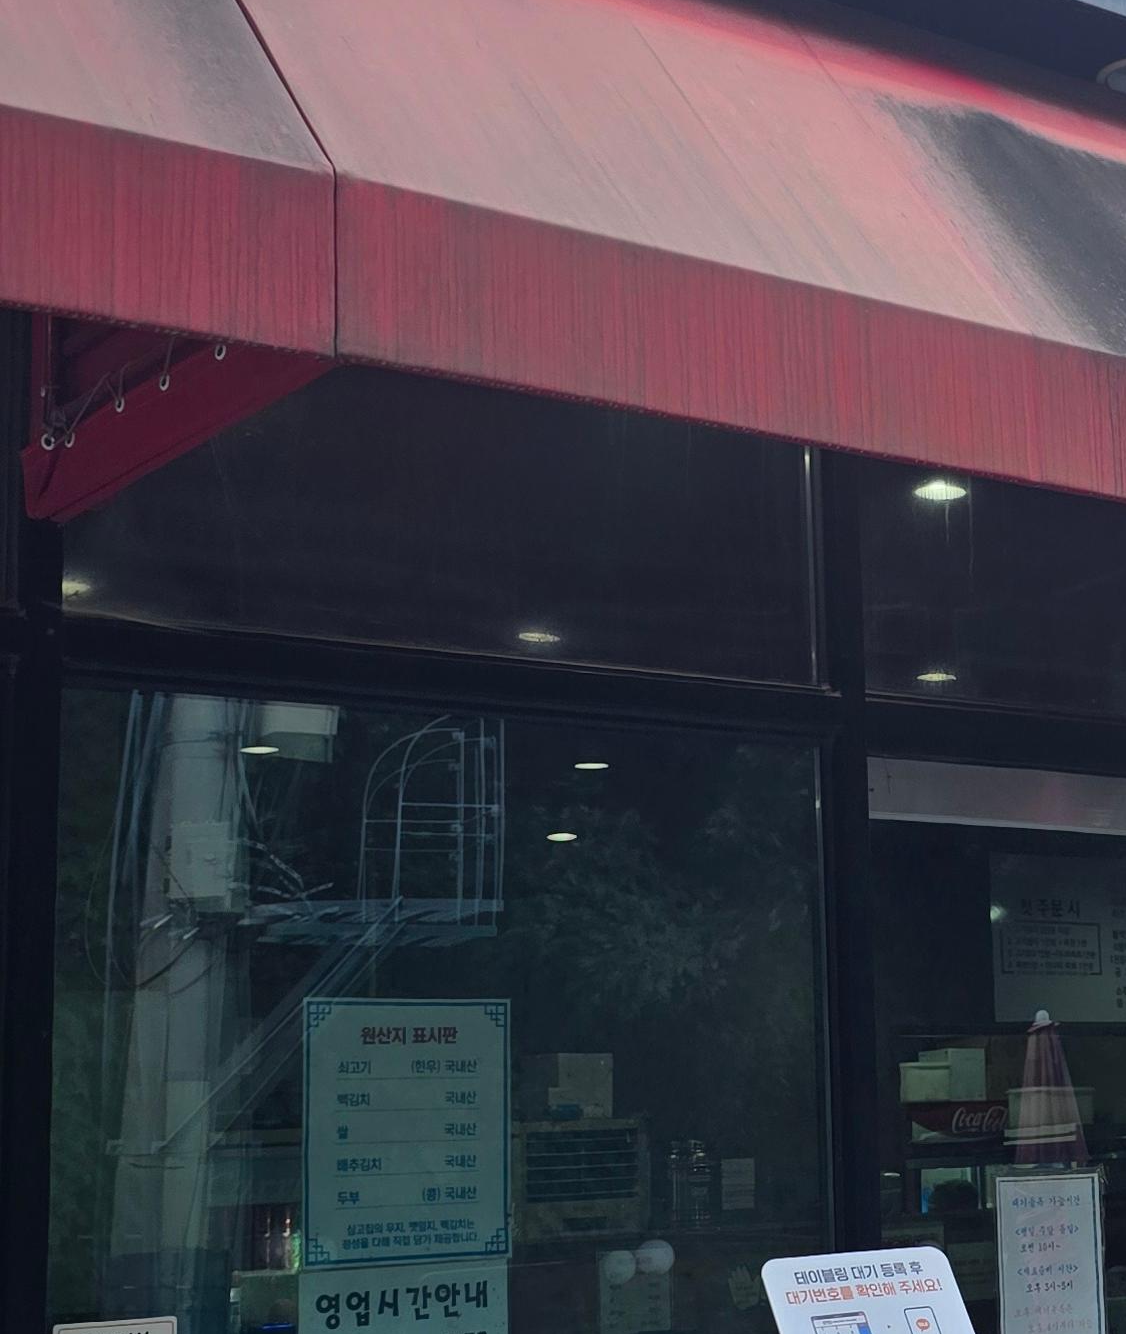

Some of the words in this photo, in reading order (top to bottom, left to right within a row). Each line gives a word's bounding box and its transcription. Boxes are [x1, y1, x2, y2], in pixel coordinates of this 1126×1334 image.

[361, 1026, 407, 1045] 원산지
[411, 1026, 458, 1044] 표시판
[338, 1060, 372, 1075] 쇠고기
[445, 1058, 478, 1073] 국내산
[337, 1092, 371, 1107] 백김치
[445, 1091, 477, 1105] 국내산
[444, 1122, 477, 1136] 국내산
[336, 1157, 382, 1172] 배추김치
[444, 1154, 477, 1169] 국내산
[337, 1189, 361, 1205] 두부
[444, 1184, 477, 1200] 국내산
[794, 1267, 848, 1285] 테이블링
[851, 1265, 878, 1280] 대기
[880, 1263, 907, 1276] 등록
[909, 1261, 924, 1274] 후
[786, 1285, 854, 1305] 대기번호를
[857, 1281, 897, 1298] 확인해
[899, 1278, 942, 1294] 주세요!
[315, 1280, 489, 1330] 영업시간안내
